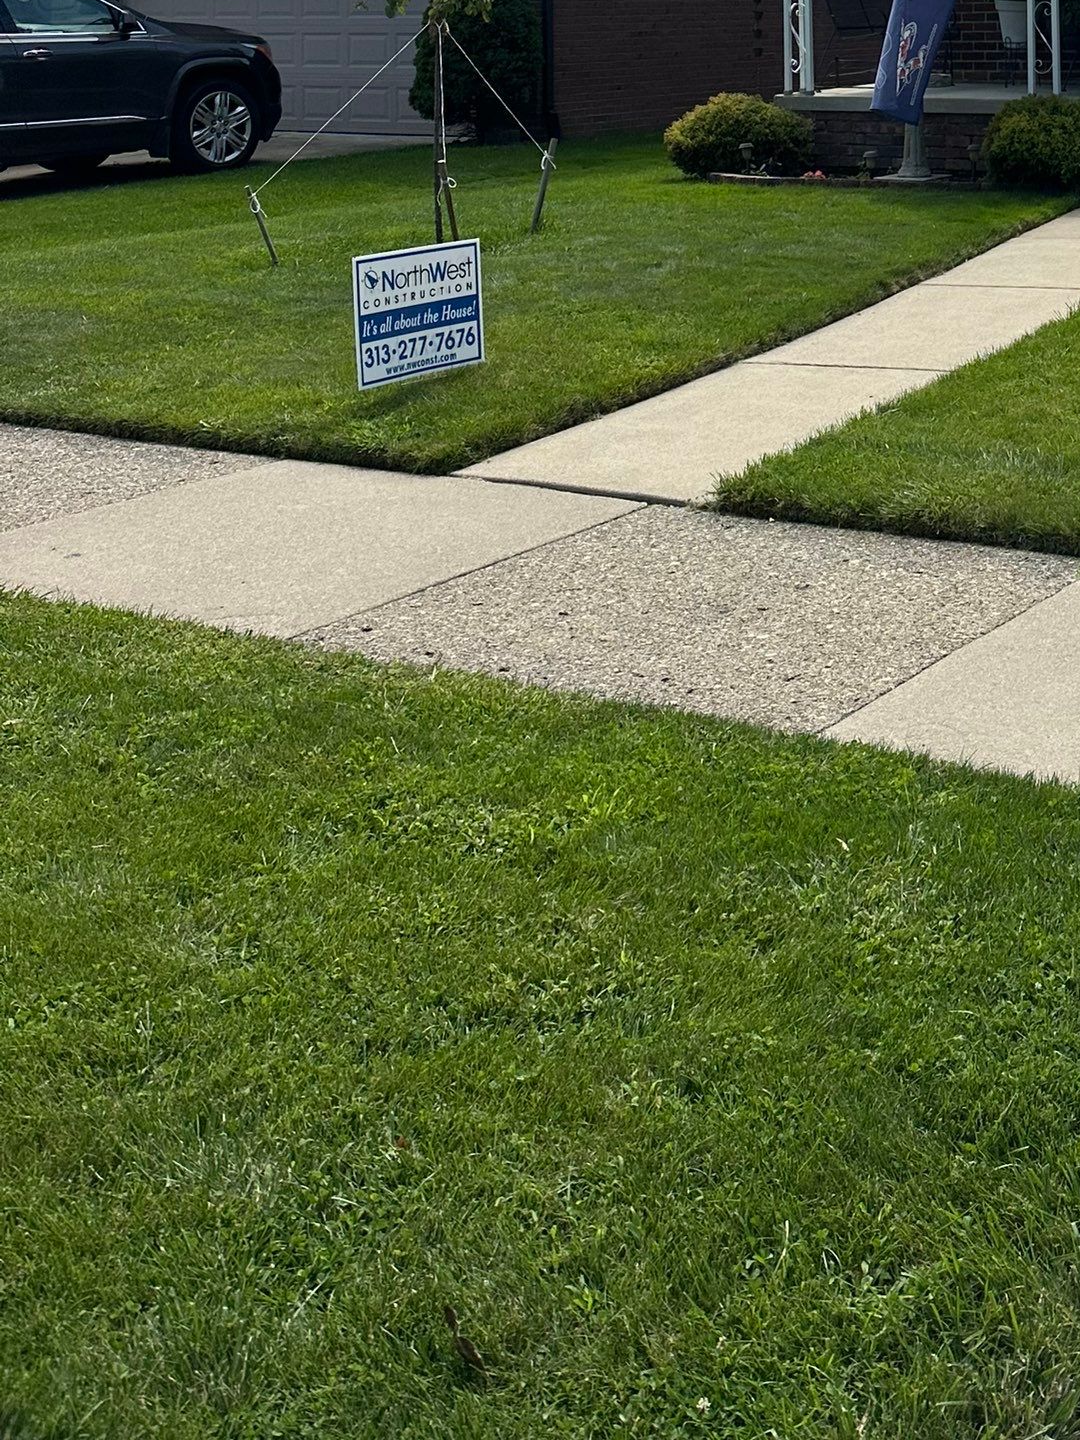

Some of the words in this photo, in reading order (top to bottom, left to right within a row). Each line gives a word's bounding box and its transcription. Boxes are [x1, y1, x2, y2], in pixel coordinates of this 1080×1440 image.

[381, 256, 473, 292] NorthWest
[363, 281, 473, 310] CONSTRUCTION
[380, 316, 392, 333] all
[394, 314, 421, 330] about
[423, 309, 439, 325] the
[441, 300, 477, 325] House!
[386, 352, 457, 375] www.nwconst.com
